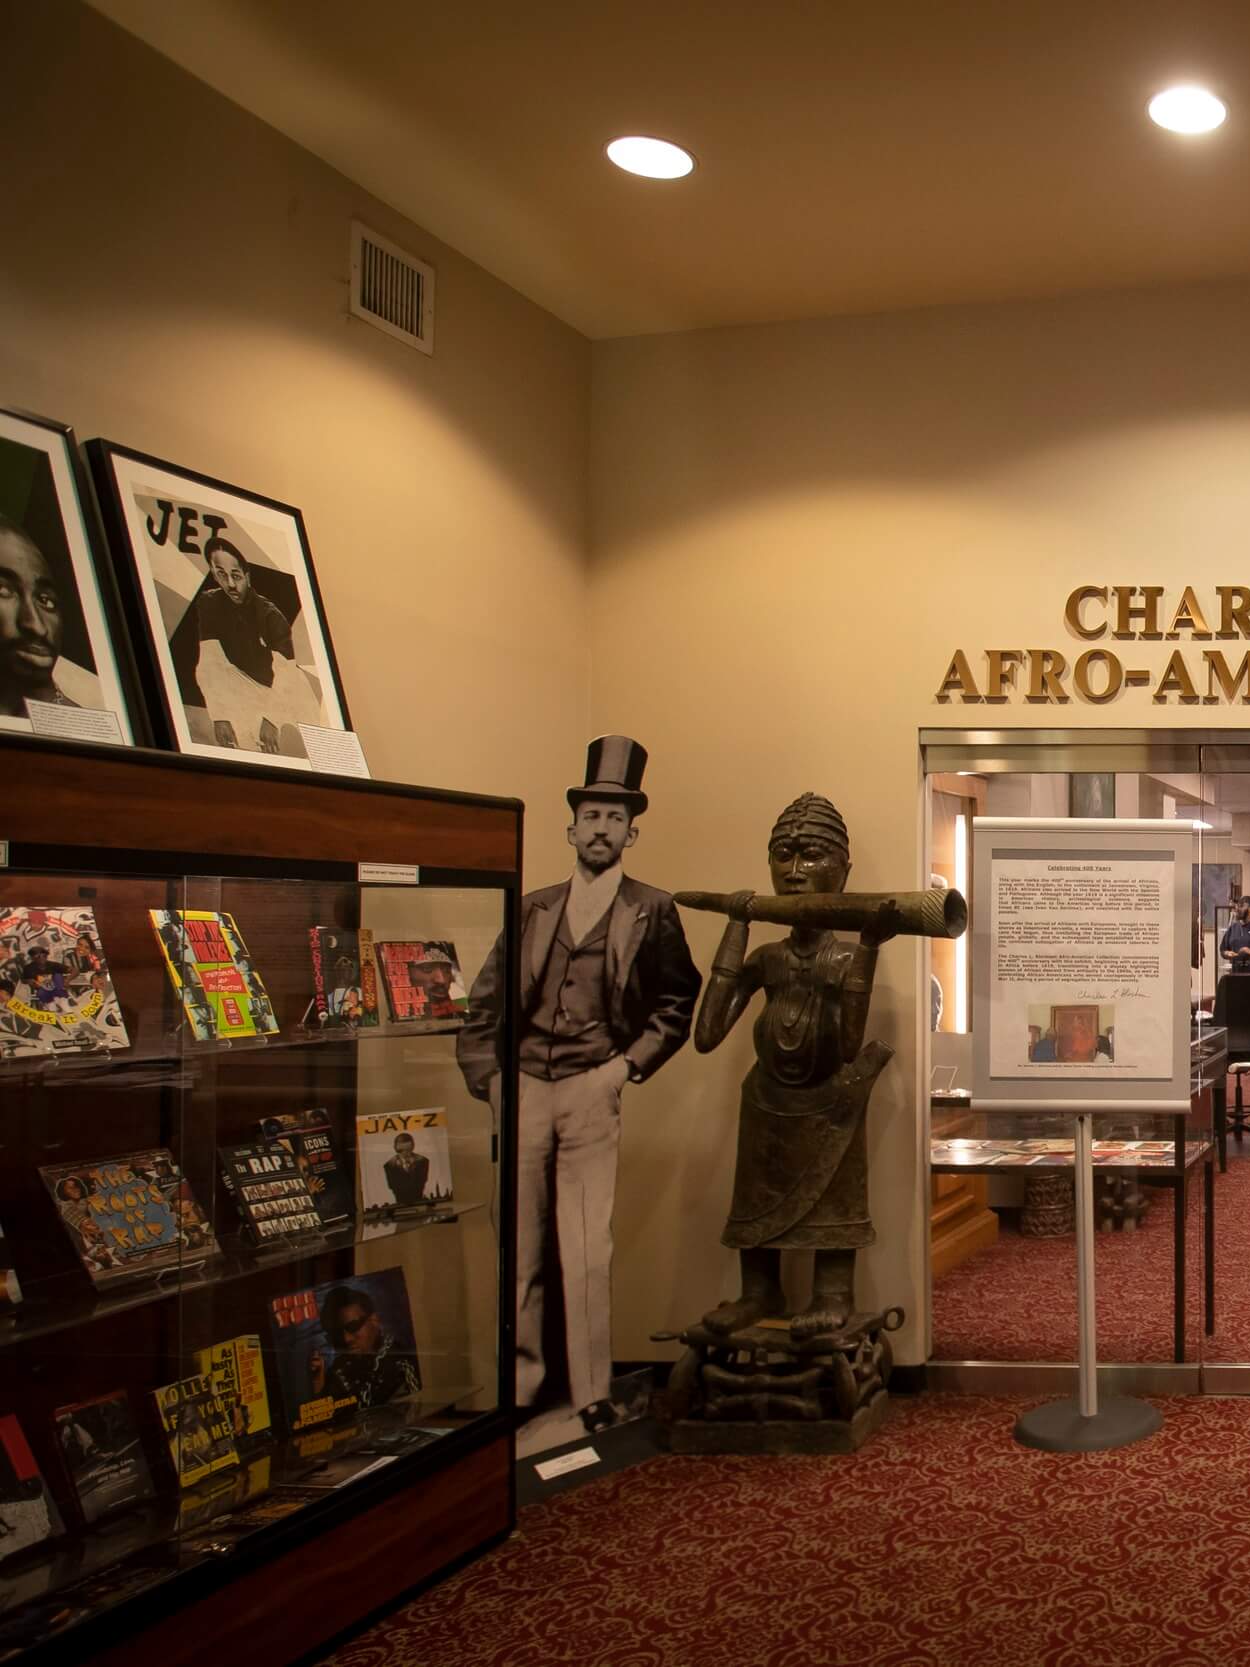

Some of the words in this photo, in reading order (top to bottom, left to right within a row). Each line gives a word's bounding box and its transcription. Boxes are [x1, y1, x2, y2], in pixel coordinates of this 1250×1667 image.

[146, 499, 228, 554] JET
[11, 1001, 54, 1024] Break
[63, 1015, 76, 1024] It
[81, 994, 102, 1018] Down
[365, 1113, 438, 1134] JAY-Z
[304, 1137, 330, 1151] ICONS
[248, 1155, 282, 1175] RAP
[89, 1166, 134, 1189] THE
[87, 1184, 165, 1216] ROOTS
[124, 1208, 146, 1224] OF
[109, 1222, 165, 1249] RAP
[197, 1400, 225, 1420] YOU
